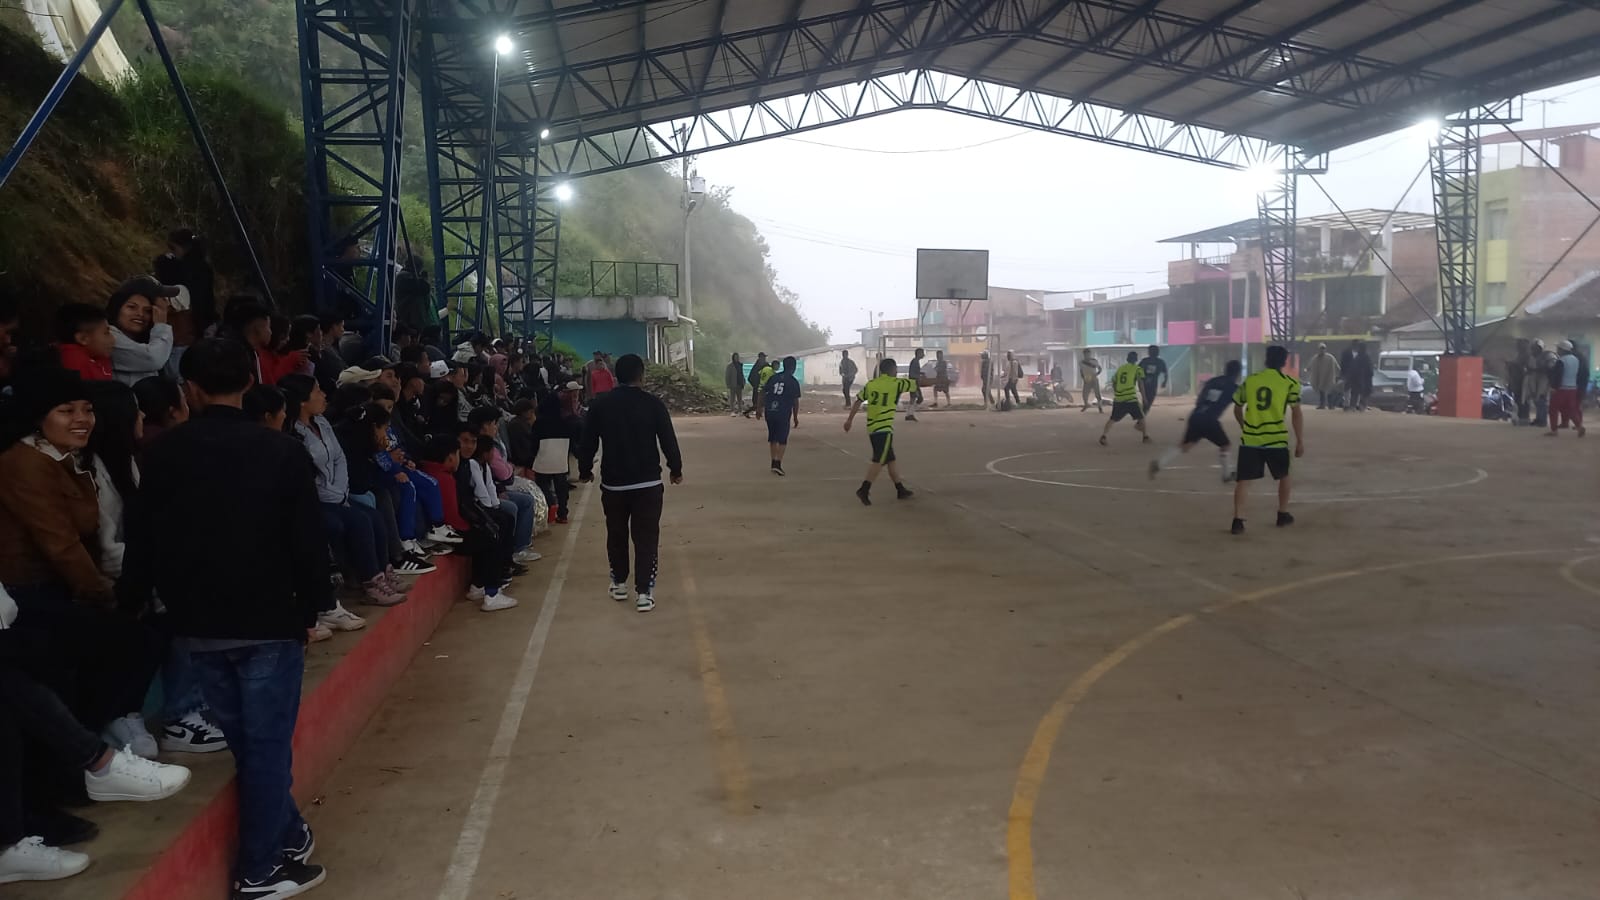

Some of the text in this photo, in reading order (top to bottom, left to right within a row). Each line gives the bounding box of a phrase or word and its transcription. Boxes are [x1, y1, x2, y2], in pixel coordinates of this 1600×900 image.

[1120, 371, 1128, 385] 6
[773, 382, 785, 395] 15
[870, 391, 889, 406] 21
[1256, 386, 1272, 411] 9
